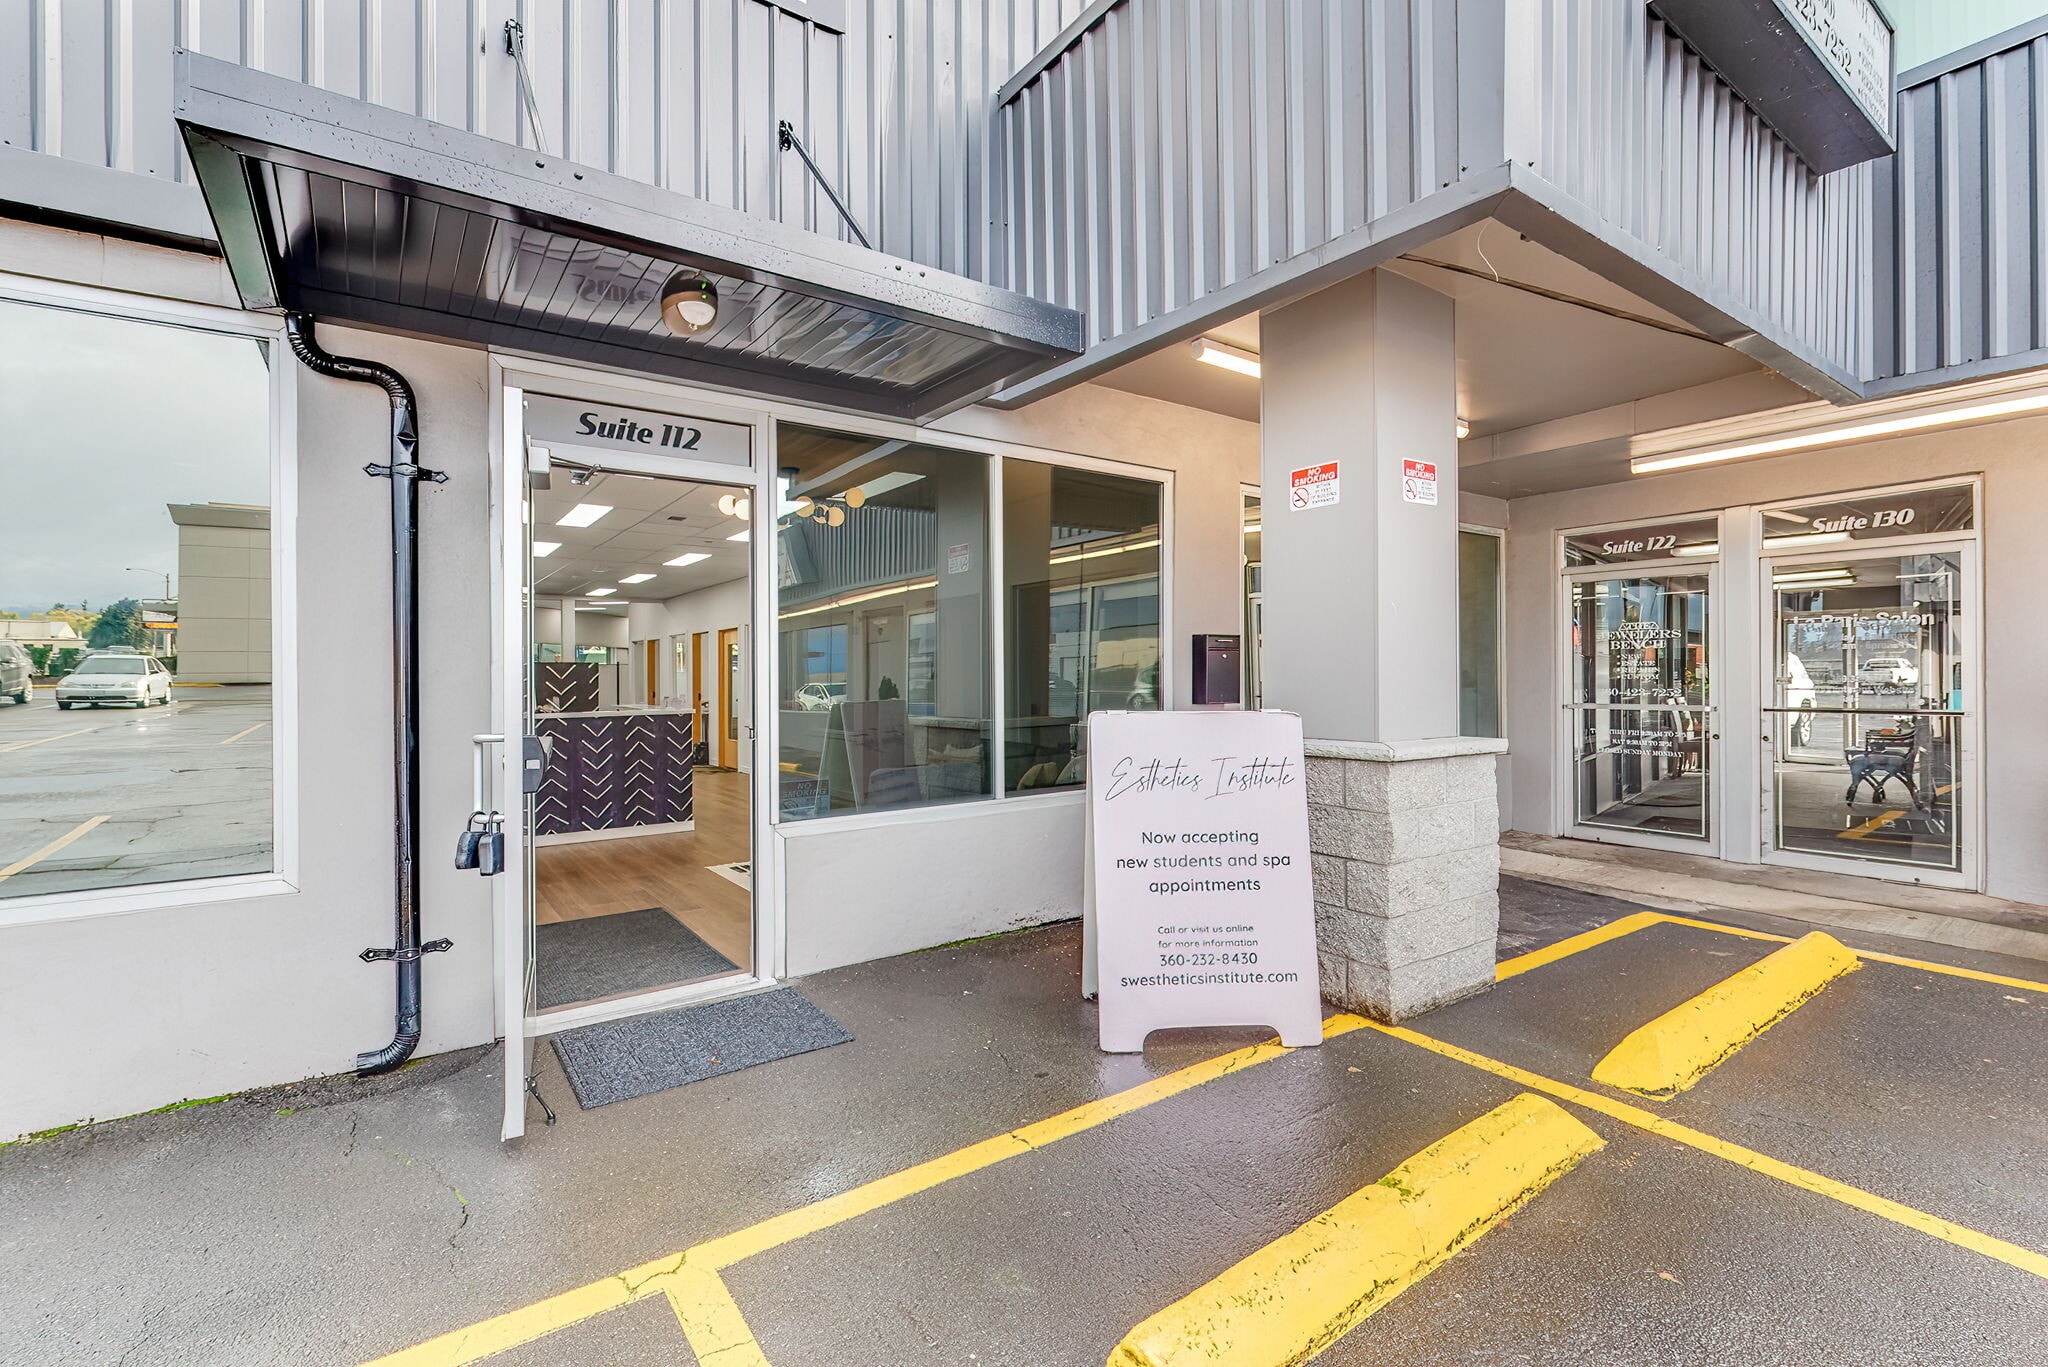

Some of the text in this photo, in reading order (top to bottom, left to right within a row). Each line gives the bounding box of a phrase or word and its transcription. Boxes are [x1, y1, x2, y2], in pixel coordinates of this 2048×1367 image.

[1795, 0, 1851, 76] 23-7252
[575, 412, 702, 451] Suite 112
[1308, 467, 1321, 477] NO
[1415, 463, 1425, 471] NO
[1294, 471, 1336, 487] SMOKING
[1810, 508, 1915, 535] Suite 130
[1601, 535, 1677, 556] Suite 122
[1876, 611, 1935, 626] Salon
[1611, 640, 1666, 650] BENCH
[1602, 687, 1682, 697] 0-423-7252
[1652, 750, 1684, 758] MONDAY
[1105, 756, 1295, 801] Esthetics Institute
[1141, 830, 1259, 846] Now accepting
[1116, 854, 1291, 870] new students and spa
[1149, 879, 1261, 896] appointments
[1157, 925, 1176, 935] Call
[1191, 925, 1210, 934] visit
[1225, 924, 1254, 933] online
[1158, 937, 1258, 948] for more information
[1160, 952, 1258, 966] 360-232-8430
[1120, 971, 1298, 988] swestheticsinstitute.com
